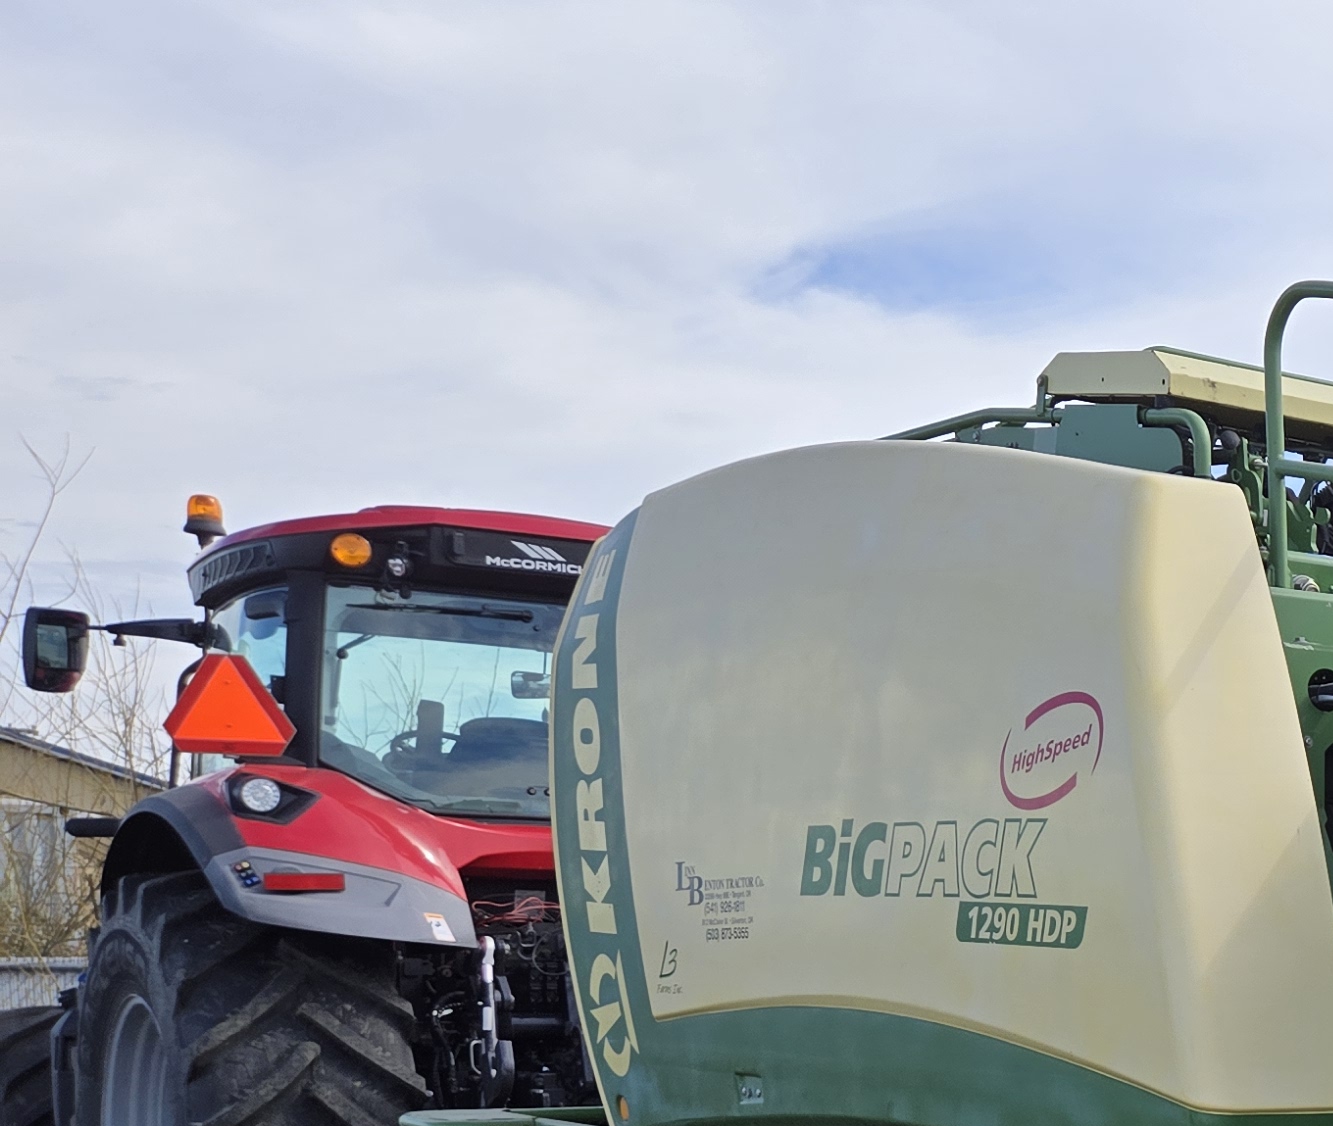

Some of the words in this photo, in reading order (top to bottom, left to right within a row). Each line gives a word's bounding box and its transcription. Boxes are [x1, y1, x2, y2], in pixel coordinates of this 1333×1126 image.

[571, 549, 617, 935] KRONE
[1011, 723, 1092, 774] HighSpeed
[726, 876, 754, 889] TRACTOR
[968, 906, 1019, 941] 1290
[1026, 909, 1077, 944] HDP
